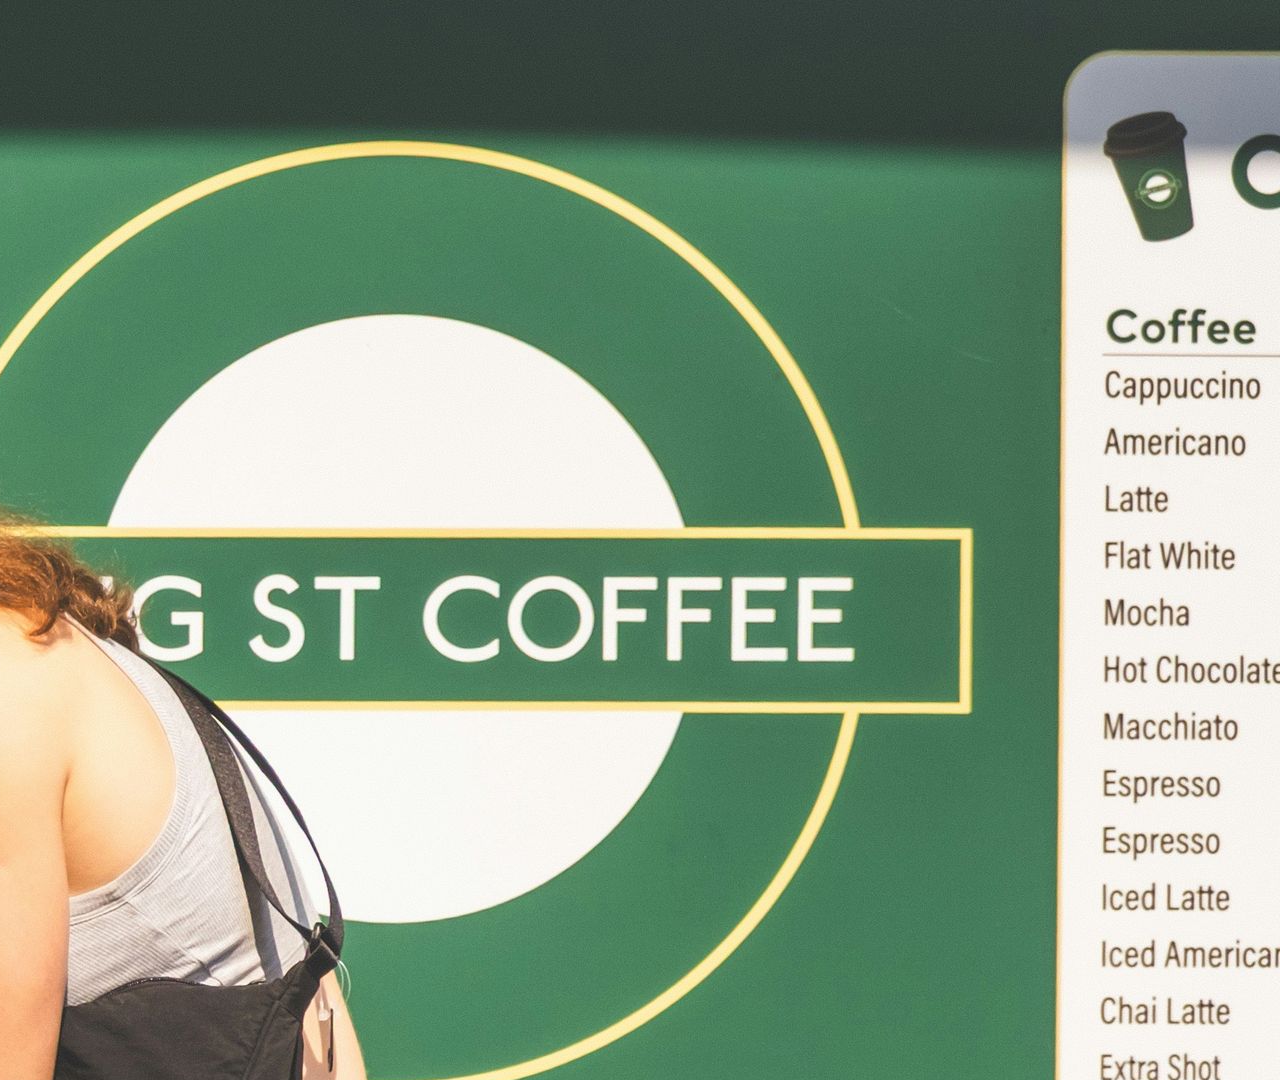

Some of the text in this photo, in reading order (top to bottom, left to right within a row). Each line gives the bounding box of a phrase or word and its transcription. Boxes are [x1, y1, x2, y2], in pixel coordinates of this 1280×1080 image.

[1105, 307, 1257, 346] Coffee
[1105, 370, 1261, 406] Cappuccino
[1104, 427, 1246, 456] Americano
[1105, 485, 1168, 512] Latte
[1105, 541, 1235, 570] Flat White
[100, 575, 854, 663] G ST COFFEE
[1105, 598, 1189, 626] Mocha
[1104, 656, 1147, 683] Hot
[1104, 712, 1238, 741] Macchiato
[1104, 770, 1220, 803] Espresso
[1103, 827, 1220, 861] Espresso
[1103, 883, 1230, 911] Iced Latte
[1102, 940, 1155, 968] Iced
[1101, 996, 1230, 1025] Chai Latte
[1101, 1055, 1158, 1080] Extra
